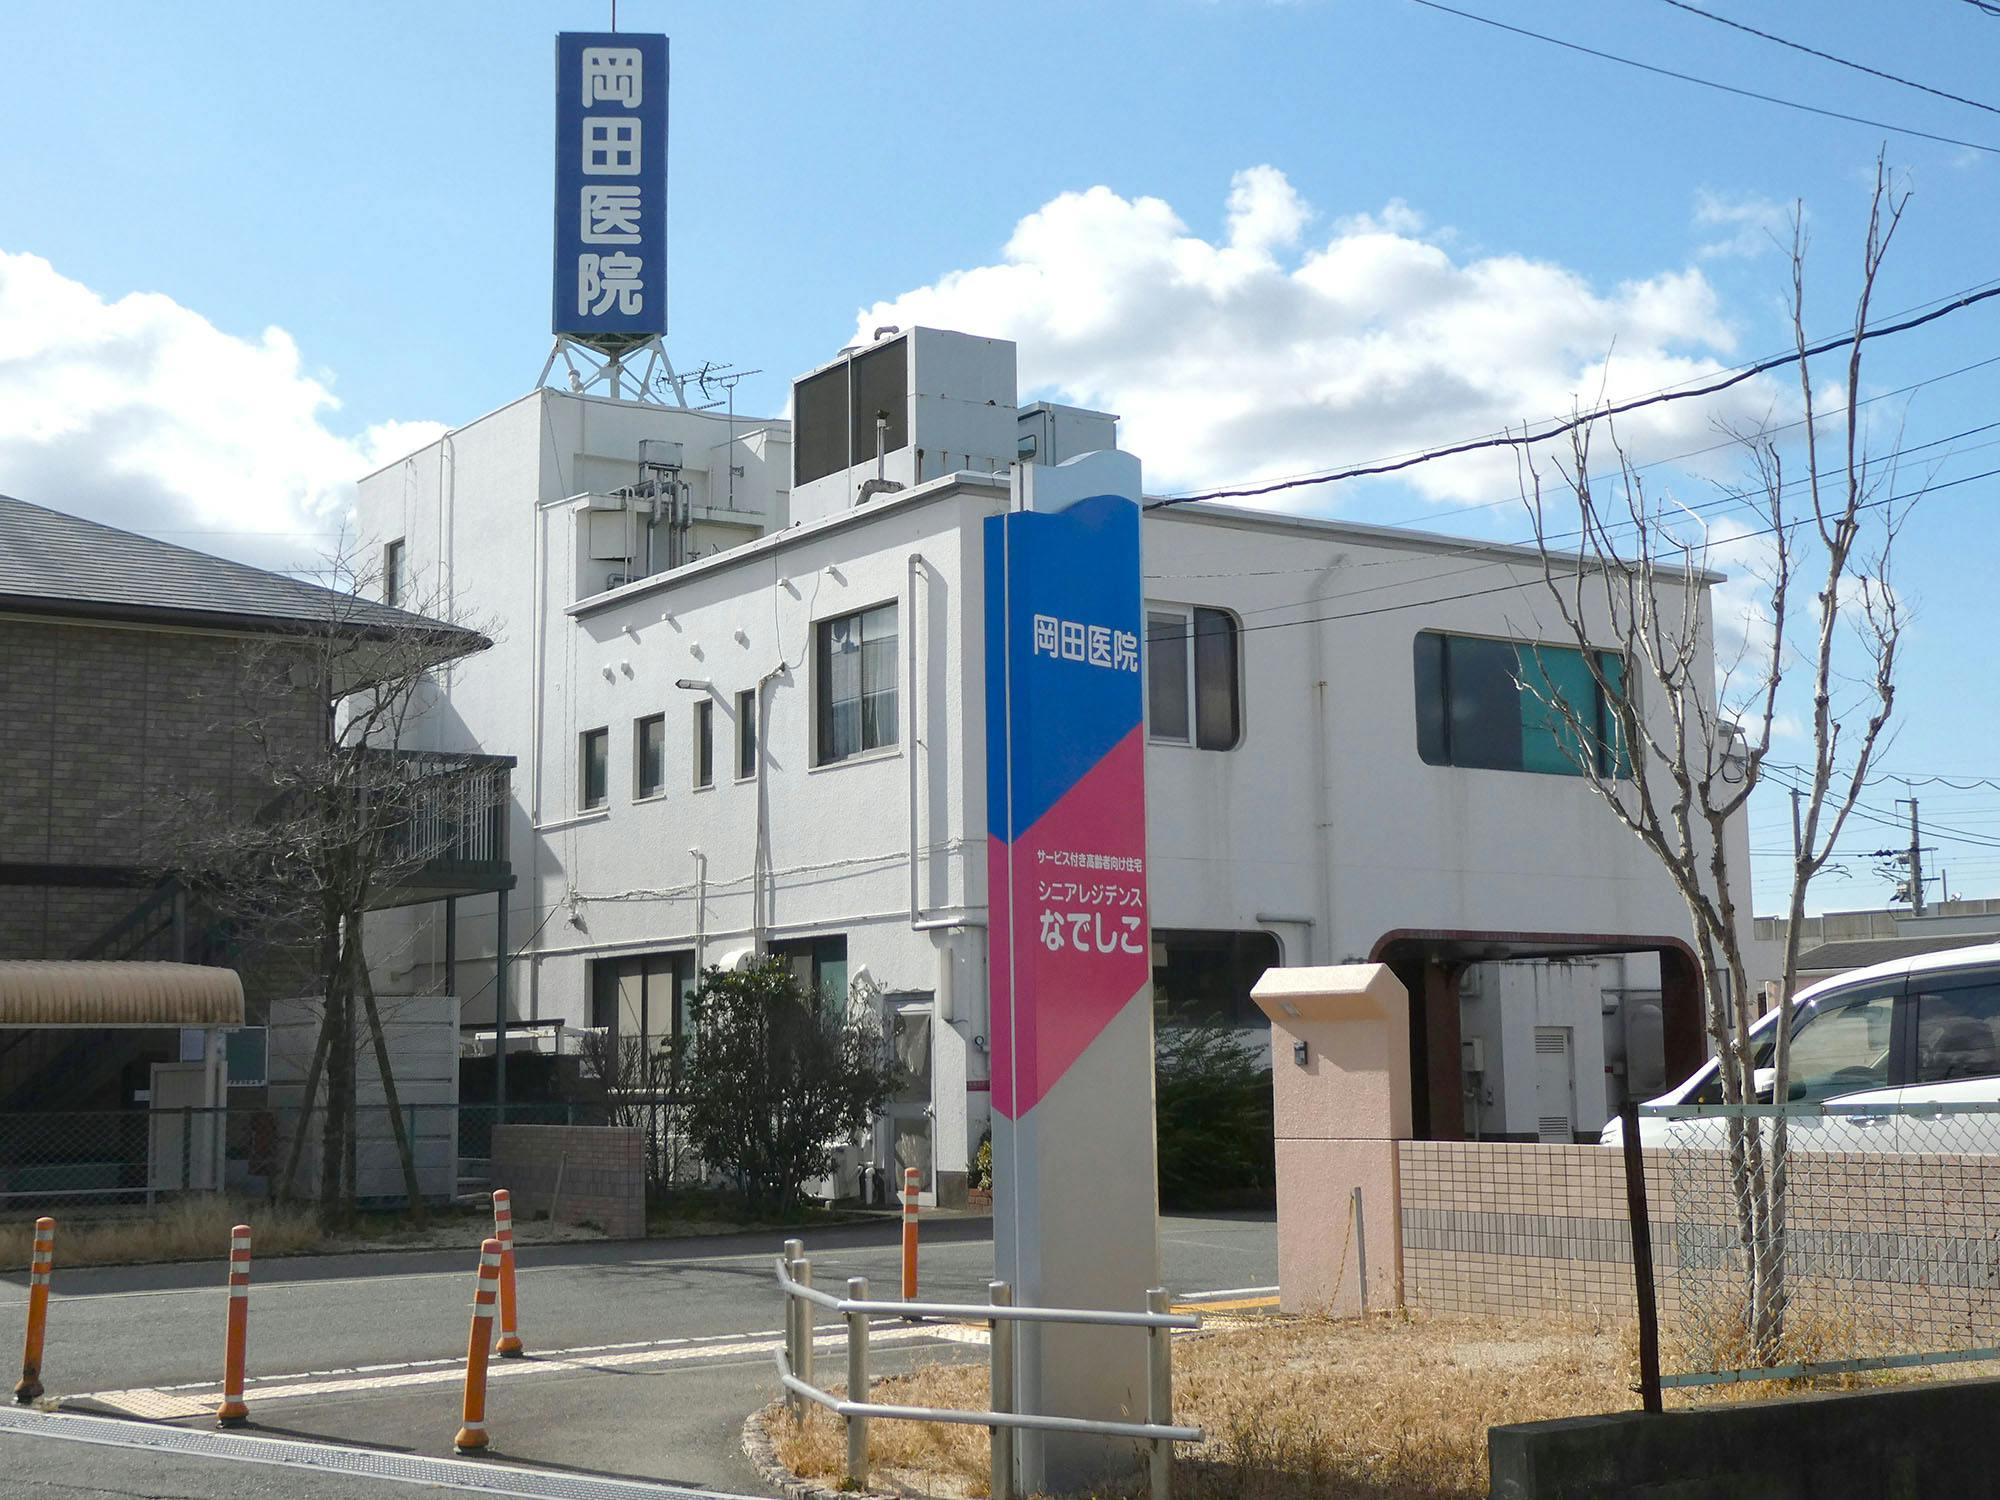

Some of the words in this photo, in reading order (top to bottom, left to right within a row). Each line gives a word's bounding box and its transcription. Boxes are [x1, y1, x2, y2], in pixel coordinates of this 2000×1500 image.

[578, 47, 644, 317] 岡田医院
[1034, 613, 1138, 673] 岡田医院
[1037, 849, 1142, 873] サービス付き高齢者向け住宅
[1038, 880, 1143, 907] シニアレジデンス
[1039, 908, 1144, 954] なでしこ
